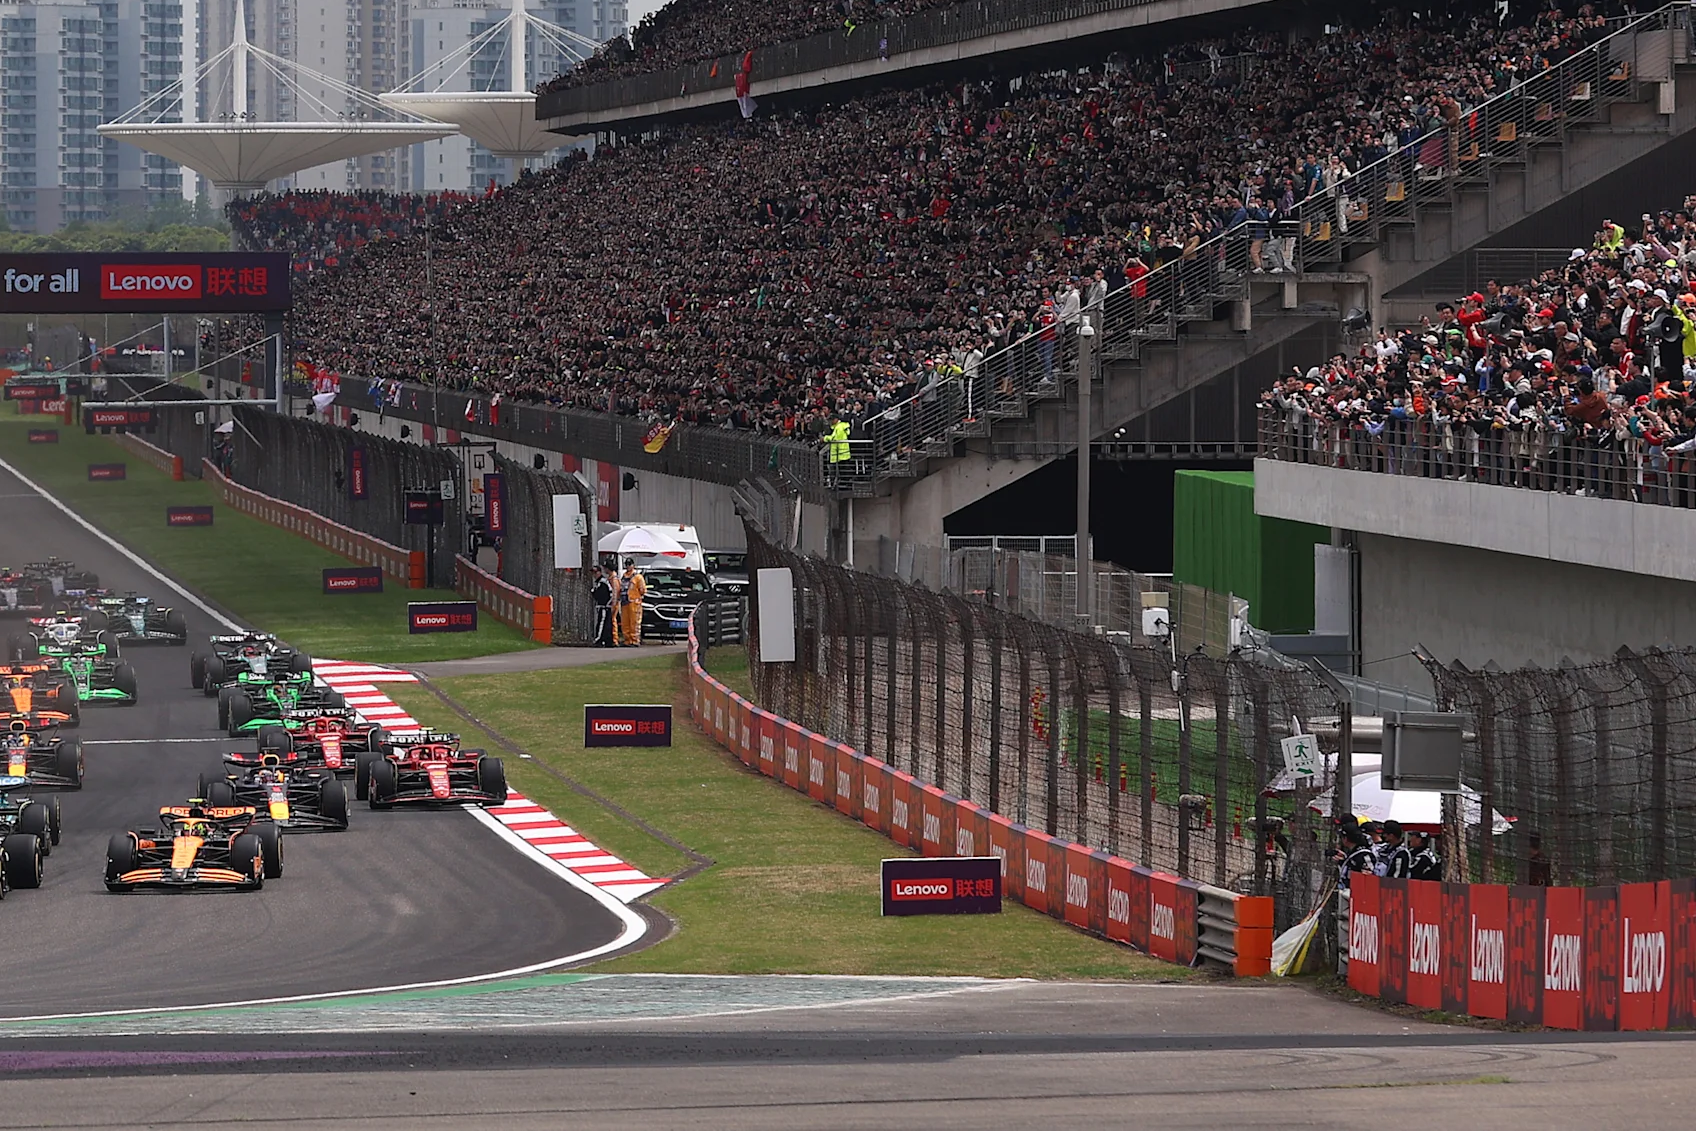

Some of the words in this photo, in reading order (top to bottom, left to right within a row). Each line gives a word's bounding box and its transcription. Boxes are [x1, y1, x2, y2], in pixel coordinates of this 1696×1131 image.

[3, 268, 45, 293] for
[48, 268, 80, 293] all
[108, 271, 194, 292] Lenovo
[206, 267, 268, 296] 联想
[492, 500, 500, 529] Lenovo
[329, 579, 356, 587] Lenovo
[416, 616, 447, 625] Lenovo
[594, 722, 633, 732] Lenovo
[637, 721, 665, 735] 联想
[896, 883, 948, 896] Lenovo
[955, 878, 994, 898] 联想
[1471, 913, 1505, 984] Lenovo
[1623, 917, 1666, 994] Lenovo
